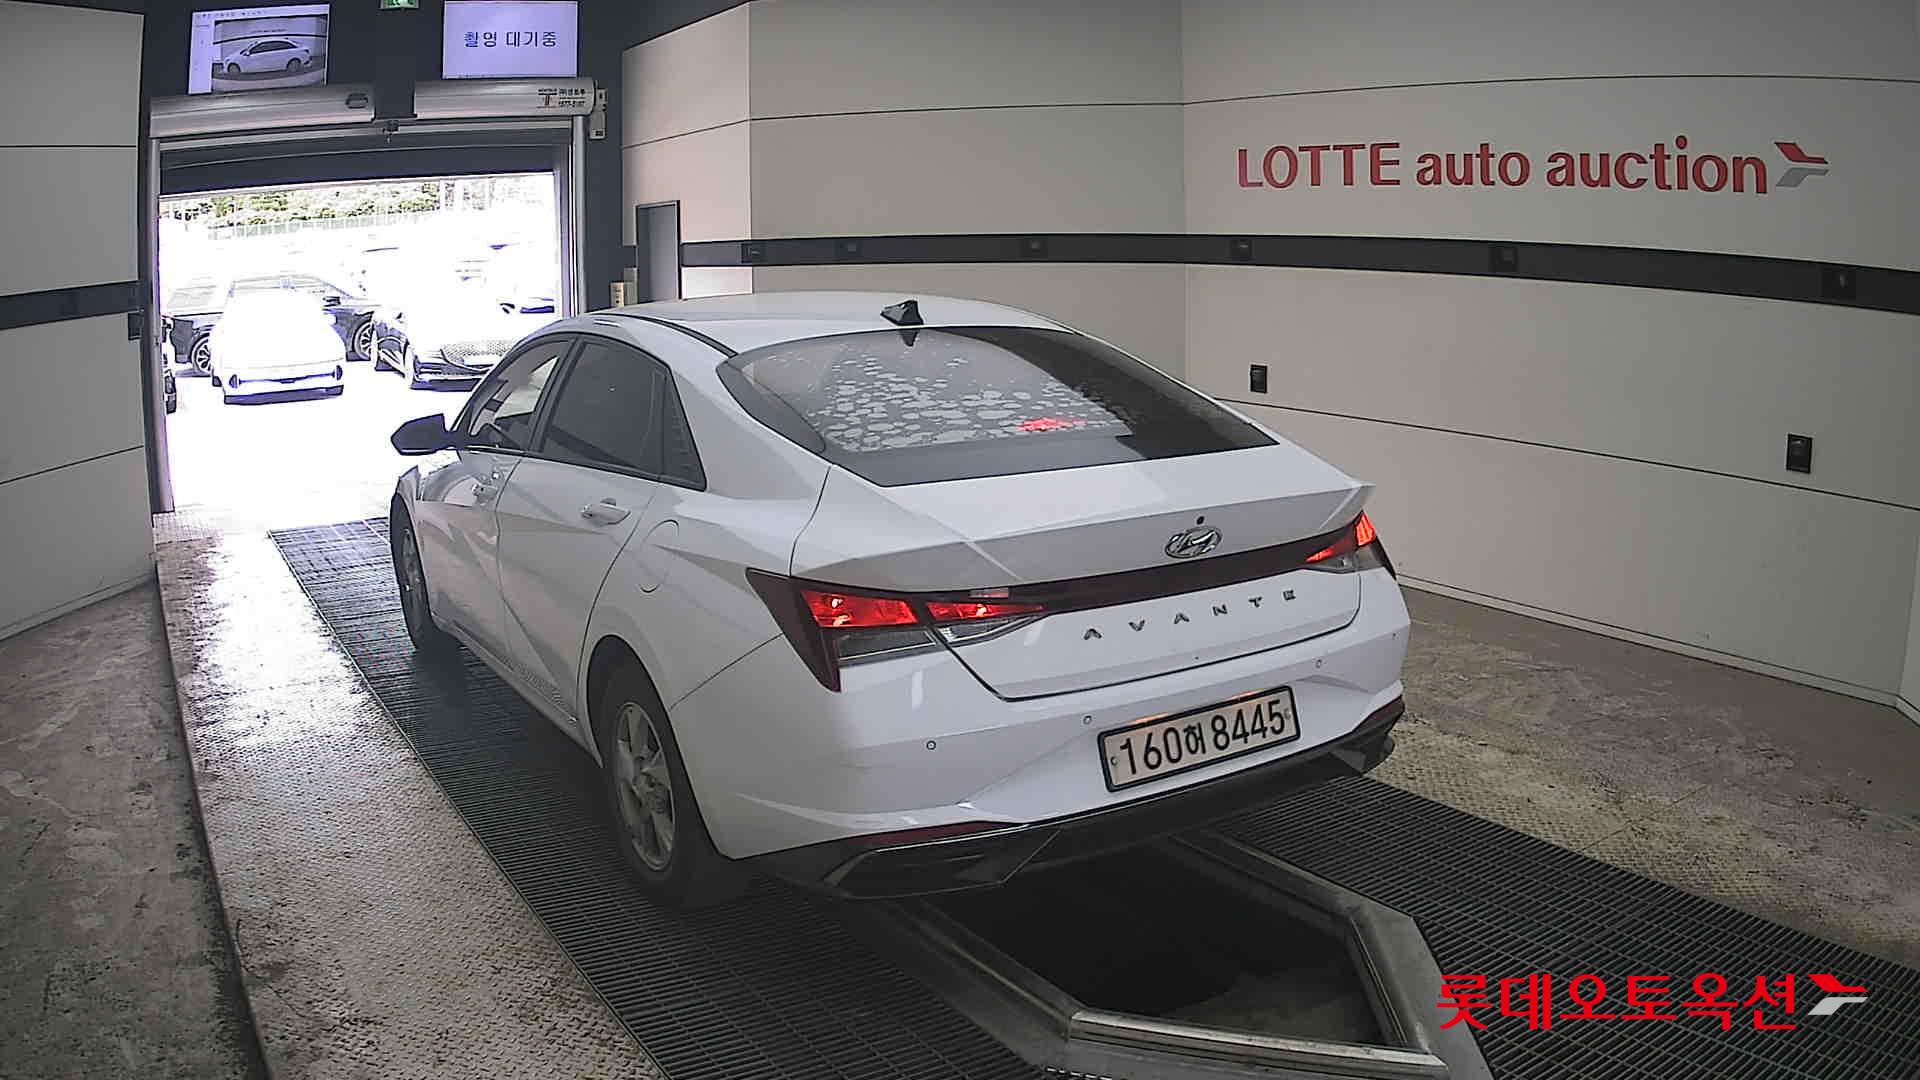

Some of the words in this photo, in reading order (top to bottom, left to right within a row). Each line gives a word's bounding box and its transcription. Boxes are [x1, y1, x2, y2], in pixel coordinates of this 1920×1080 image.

[506, 31, 556, 48] 대기중
[1237, 142, 1400, 188] LOTTE
[1416, 143, 1530, 187] auto
[1546, 135, 1767, 194] auction
[1084, 589, 1296, 640] AVANTE
[1211, 699, 1285, 751] 8445
